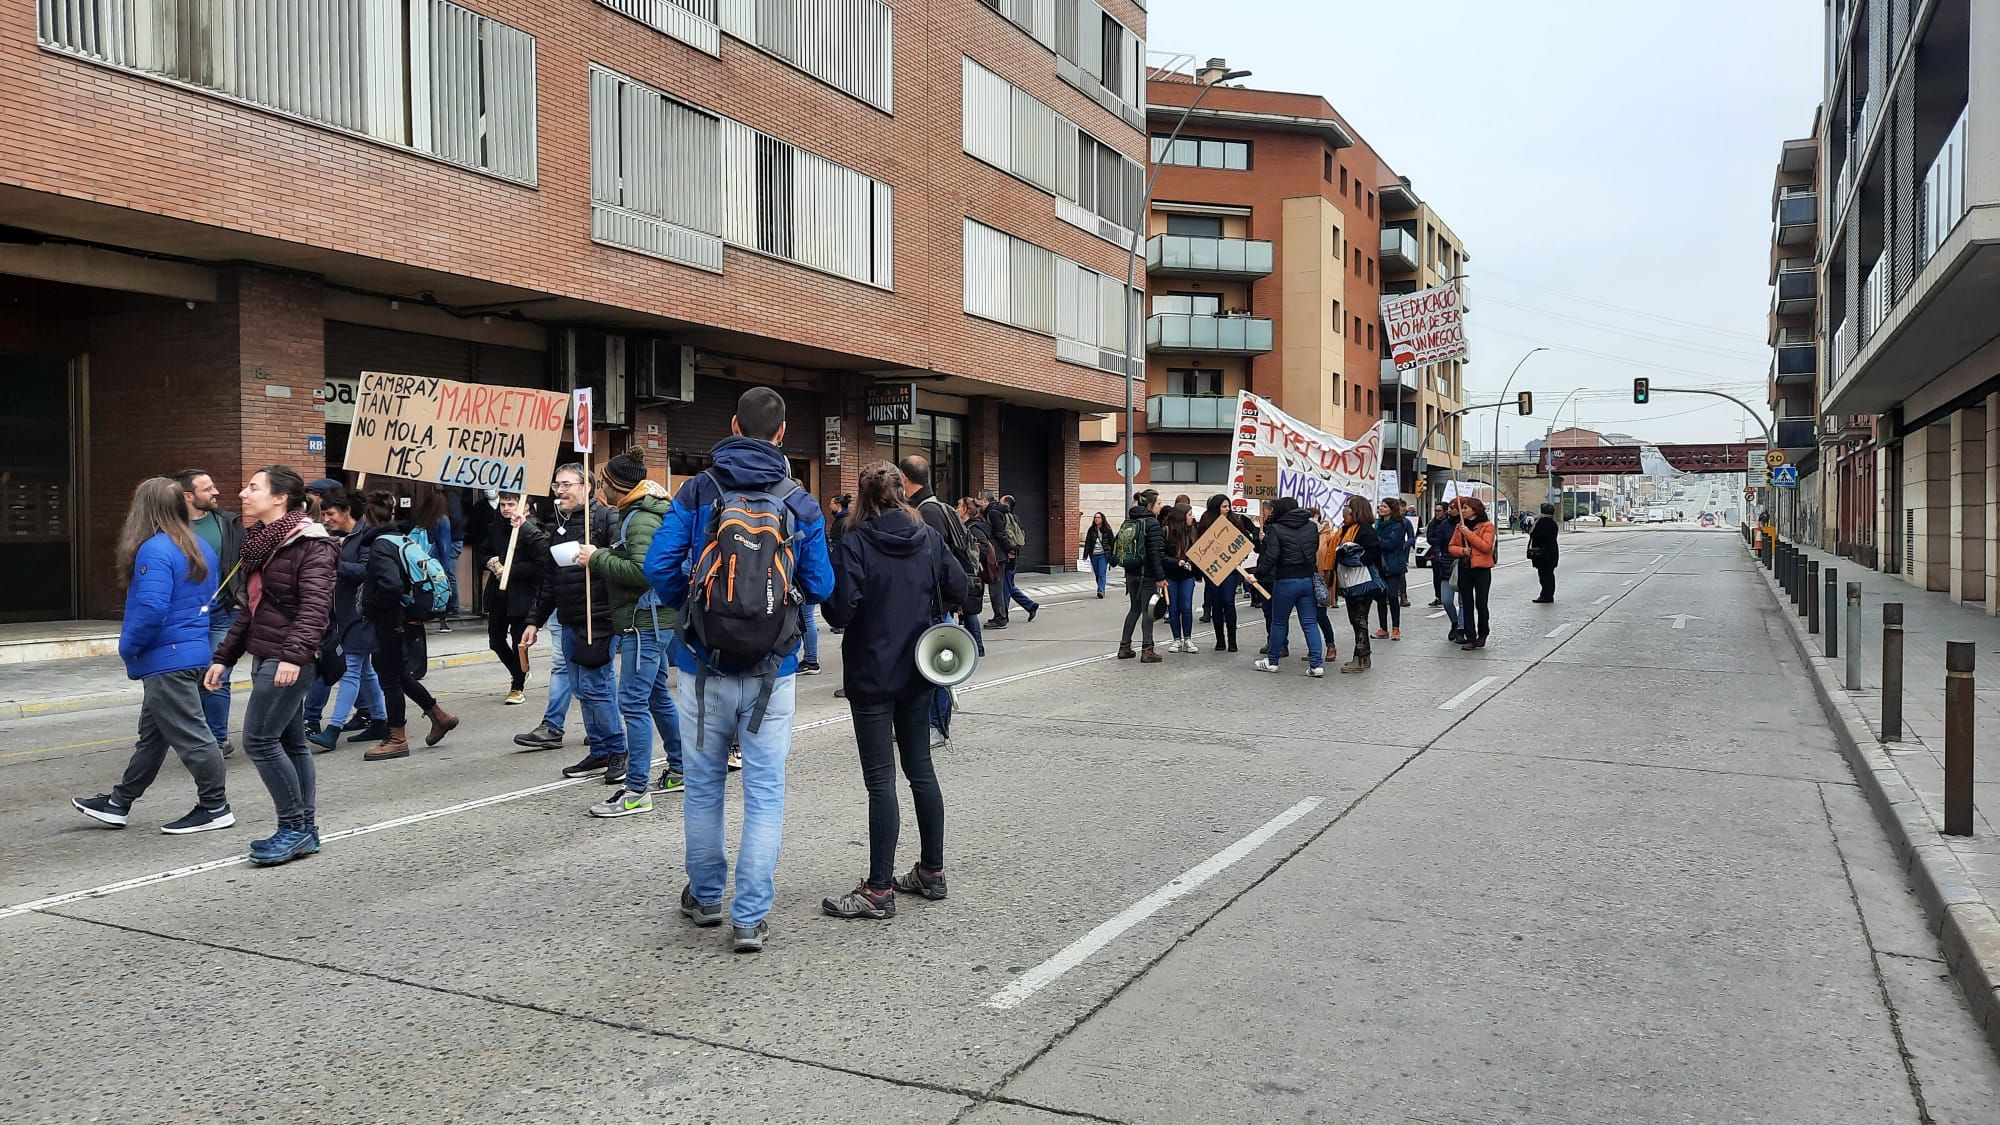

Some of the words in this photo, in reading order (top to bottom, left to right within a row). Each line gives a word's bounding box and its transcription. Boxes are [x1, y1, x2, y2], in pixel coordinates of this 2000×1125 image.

[1391, 322, 1410, 340] NO
[1413, 321, 1427, 334] HA
[1429, 315, 1441, 331] DE
[1440, 309, 1460, 327] SER
[1412, 334, 1427, 352] UN
[1427, 323, 1463, 348] NEGOCI
[1396, 360, 1417, 371] CGT
[364, 374, 439, 402] CAMBRAY,
[361, 392, 411, 417] TANT
[436, 383, 566, 432] MARKETING
[867, 403, 909, 422] JORSU'S
[1242, 408, 1258, 416] CGT
[309, 440, 323, 451] RB
[356, 416, 376, 437] NO
[384, 418, 437, 450] MOLA,
[447, 426, 525, 458] TREPITJA
[1239, 432, 1256, 440] CGT
[440, 455, 525, 491] L'ESCOLA
[1280, 469, 1356, 522] MARKET
[1231, 506, 1248, 514] CGT
[1205, 559, 1222, 578] FOT
[1219, 552, 1232, 563] EL
[1228, 534, 1247, 554] CAMP
